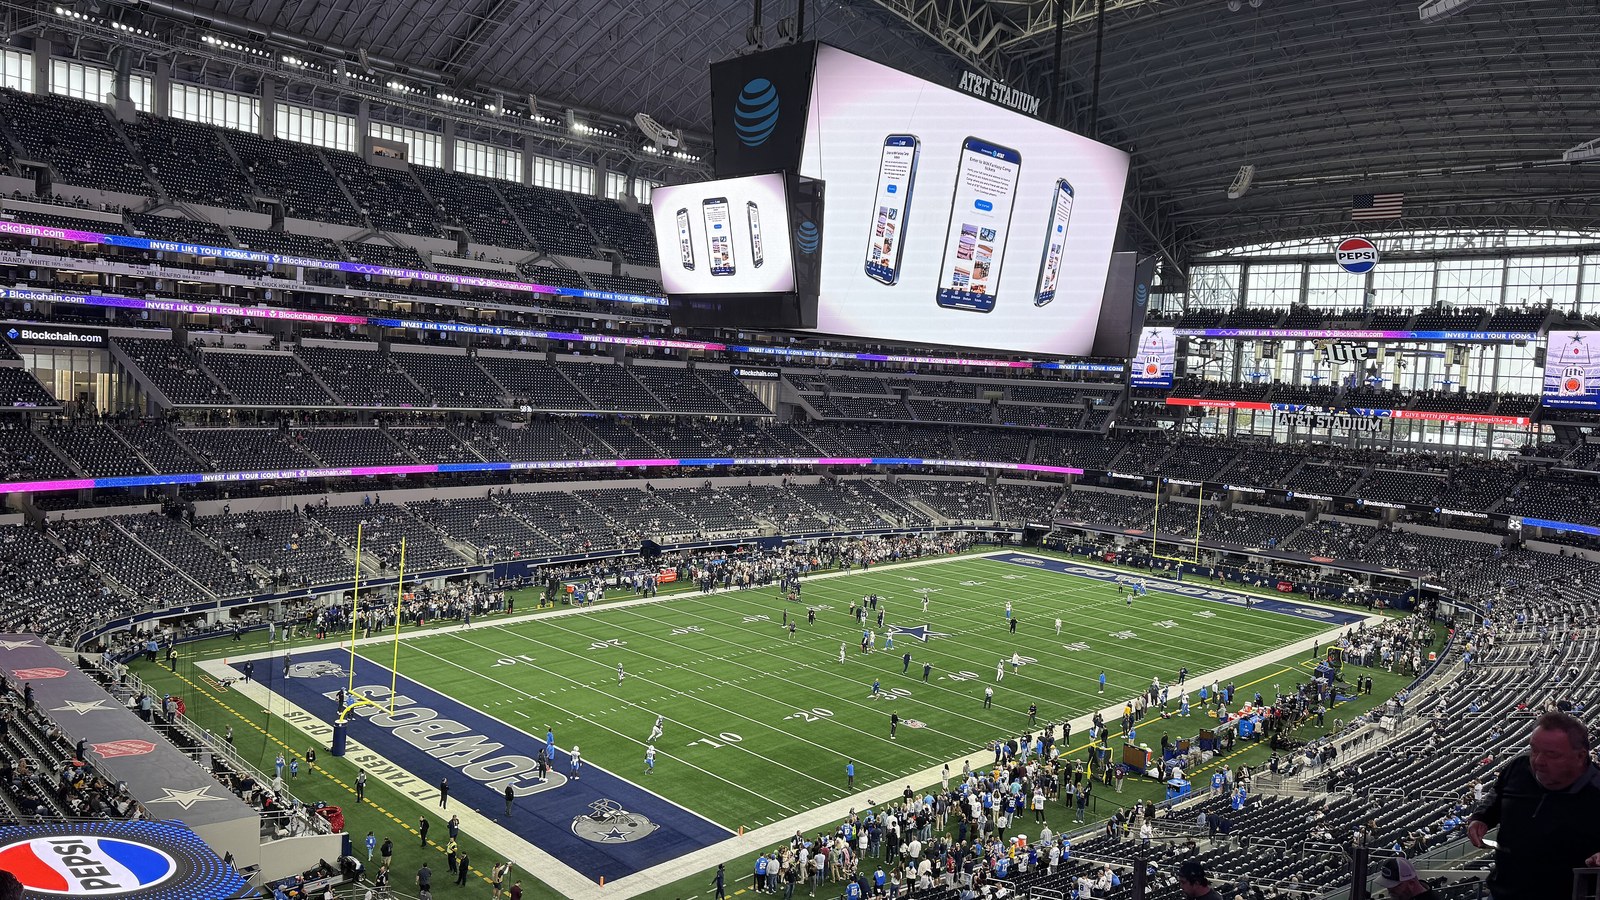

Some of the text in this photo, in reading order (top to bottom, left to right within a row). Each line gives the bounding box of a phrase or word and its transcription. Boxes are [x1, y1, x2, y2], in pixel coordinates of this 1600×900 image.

[958, 70, 1041, 116] AT&T STADIUM
[3, 256, 25, 264] RANDY
[150, 241, 340, 269] INVEST LIKE YOUR ICONS WITH Blockchain.com
[1338, 251, 1375, 260] PEPSI
[382, 269, 404, 277] INVEST
[440, 275, 459, 283] ICONS
[486, 280, 533, 291] Blockchain.com
[9, 291, 85, 303] Blockchain.com
[145, 302, 174, 310] INVEST
[220, 307, 244, 315] ICONS
[279, 312, 336, 321] Blockchain.com
[22, 330, 102, 343] Blockchain.com
[503, 328, 548, 337] Blockchain.com
[1325, 343, 1368, 365] Lite
[739, 369, 779, 378] Blockchain.com
[1564, 368, 1583, 378] Lite
[1280, 413, 1381, 432] AT&T STADIUM
[306, 469, 352, 477] Blockchain.com
[1112, 472, 1144, 480] Blockchain.com
[1228, 485, 1266, 494] Blockchain.com
[1293, 492, 1333, 501] Blockchain.com
[1363, 500, 1406, 509] Blockchain.com
[1441, 509, 1488, 518] Blockchain.com
[591, 639, 628, 649] 20
[497, 654, 536, 666] 10
[948, 670, 980, 682] 40
[793, 707, 834, 723] 20
[322, 684, 568, 797] COWBOYS
[698, 732, 743, 749] 10
[283, 710, 440, 801] IT TAKES OF US
[47, 839, 122, 890] PEPSI
